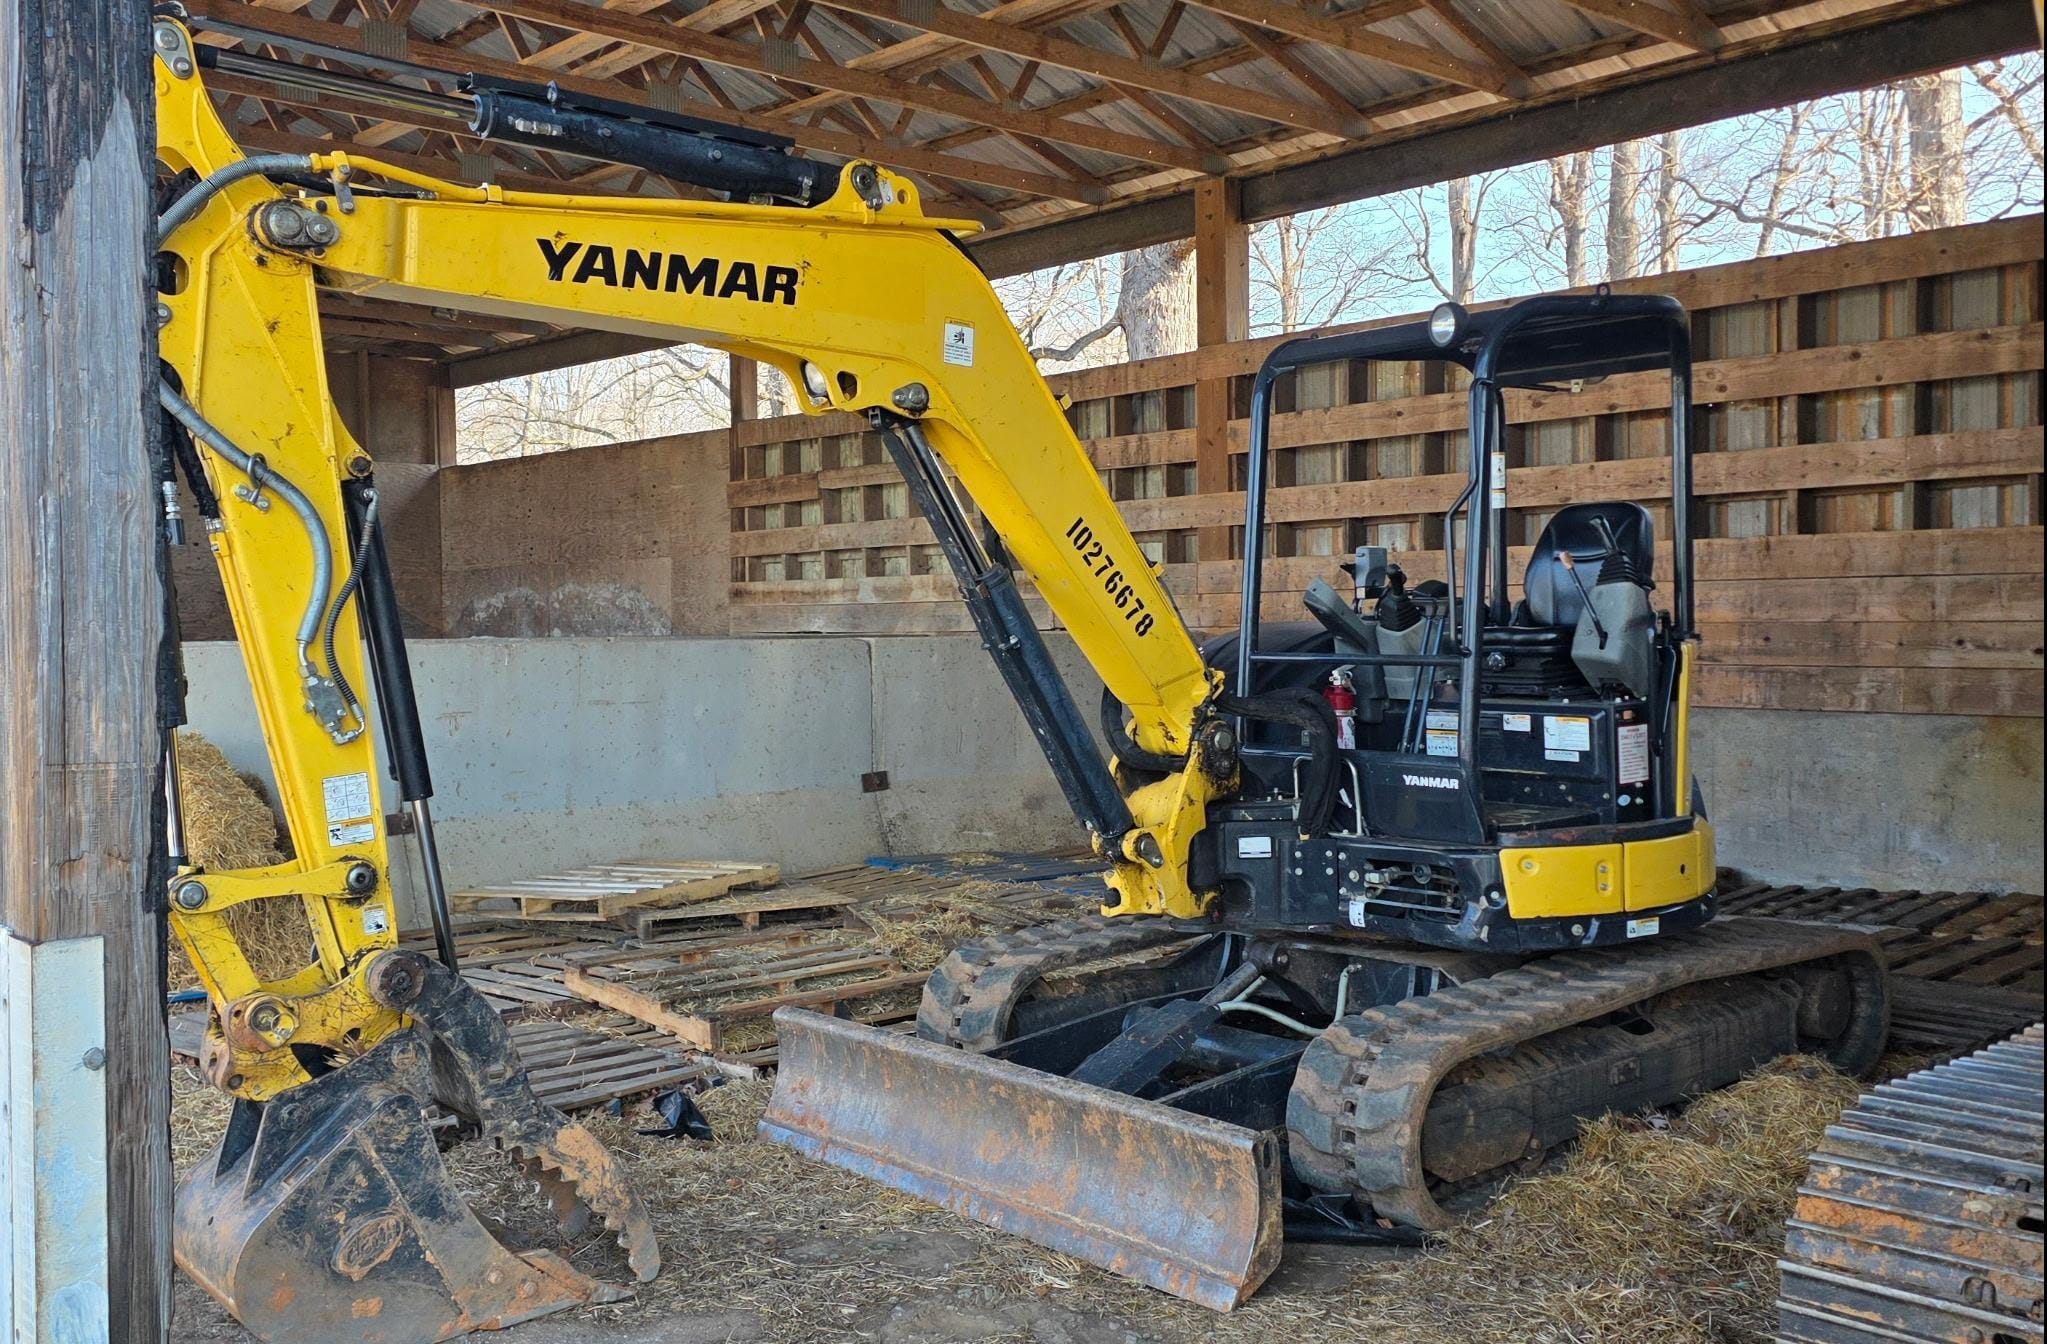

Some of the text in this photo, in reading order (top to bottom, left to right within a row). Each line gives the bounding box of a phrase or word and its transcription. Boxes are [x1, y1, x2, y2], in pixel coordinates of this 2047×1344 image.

[537, 238, 799, 306] YANMAR
[1066, 516, 1154, 637] 10276678
[1402, 774, 1459, 790] YANMAR
